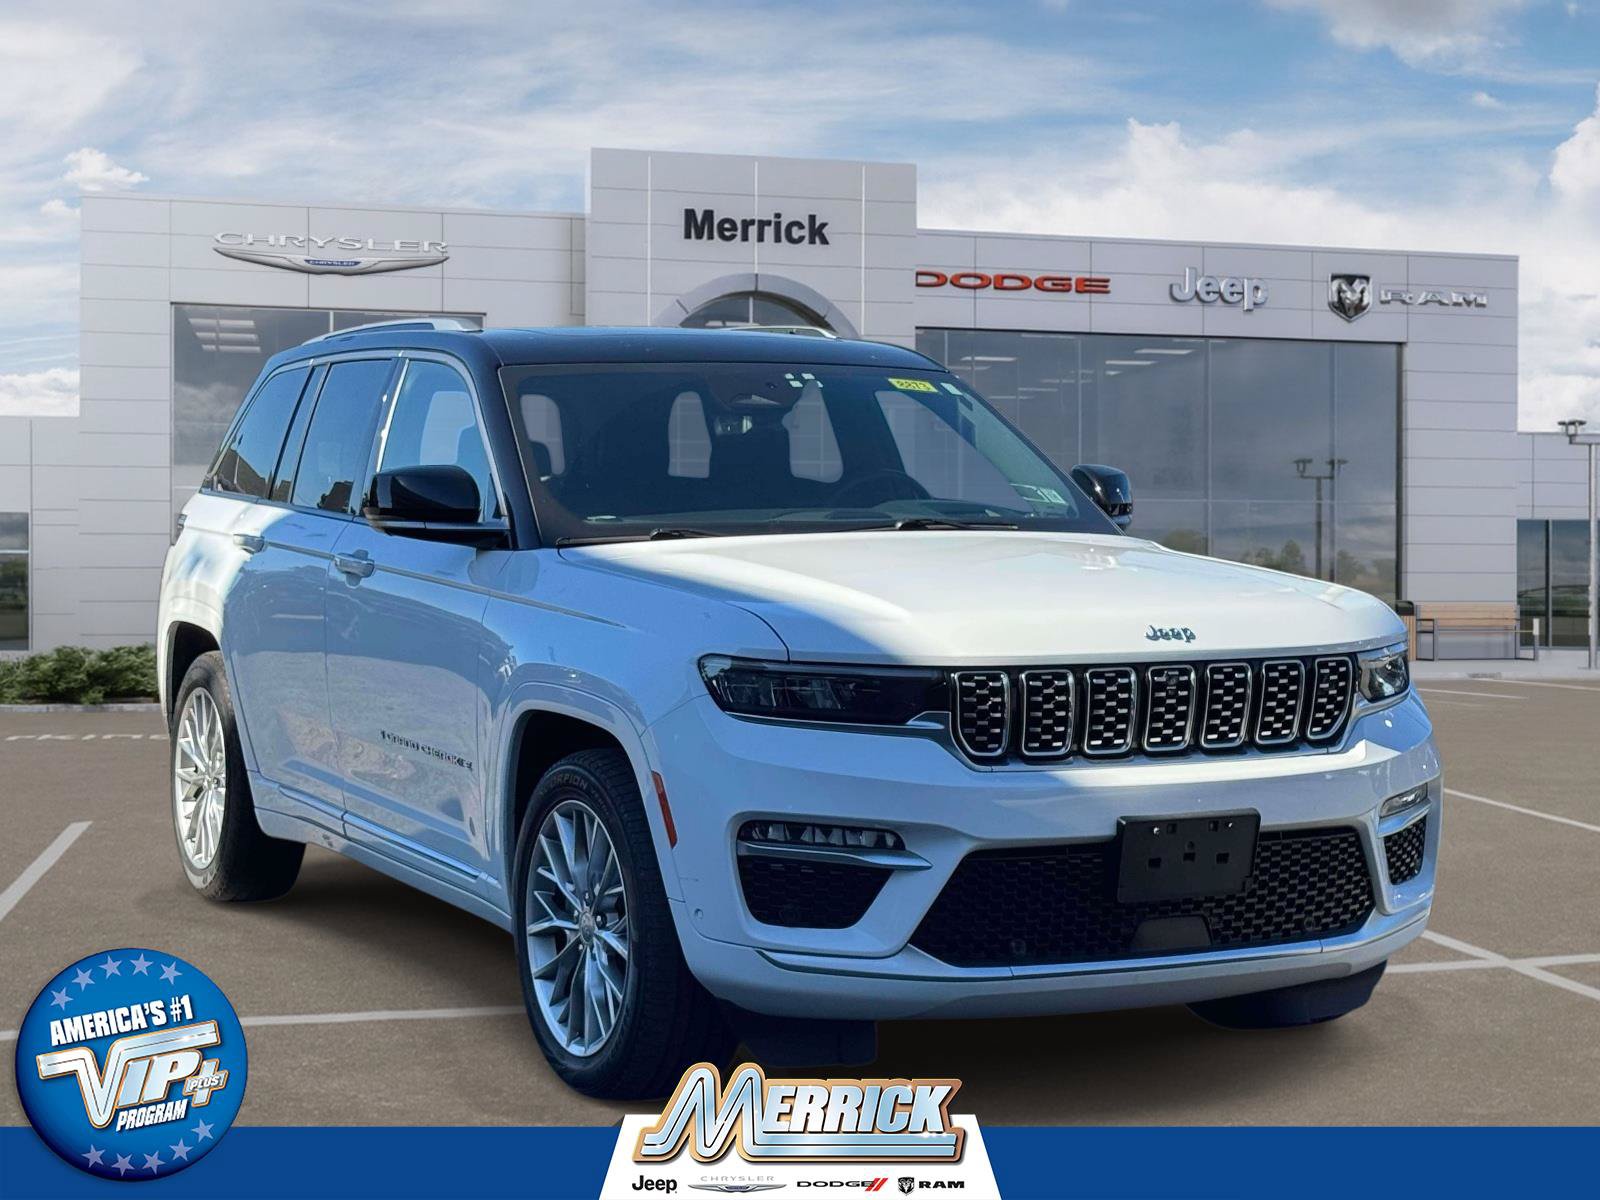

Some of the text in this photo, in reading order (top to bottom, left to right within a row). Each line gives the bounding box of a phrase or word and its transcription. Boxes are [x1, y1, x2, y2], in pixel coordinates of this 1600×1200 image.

[684, 208, 829, 245] Merrick
[214, 232, 449, 253] CHRYSLER
[915, 271, 1111, 294] DODGE
[1170, 266, 1268, 312] Jeep
[1379, 290, 1488, 308] RAM
[1145, 625, 1196, 643] Jeep
